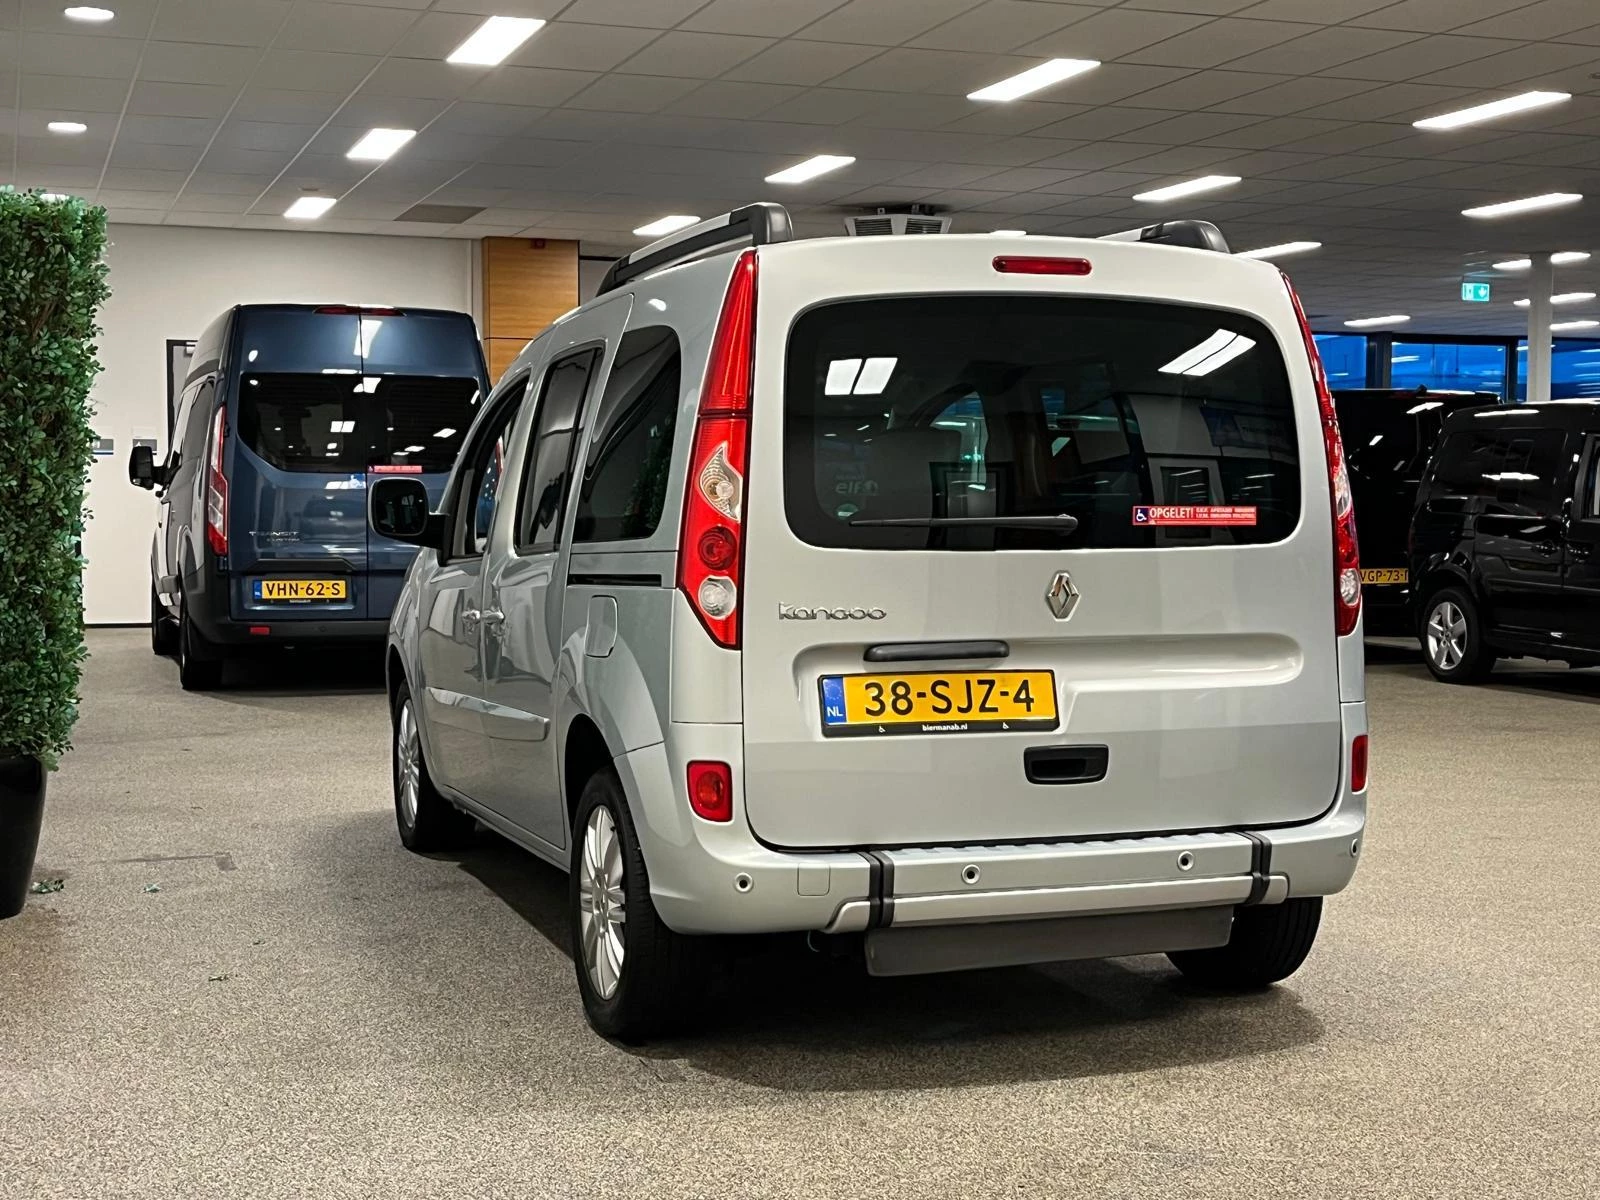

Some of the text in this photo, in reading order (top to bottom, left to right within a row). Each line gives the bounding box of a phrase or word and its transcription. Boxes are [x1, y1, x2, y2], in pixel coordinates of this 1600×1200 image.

[1149, 507, 1194, 519] OPGELET!
[265, 582, 341, 597] VHN-62-S
[778, 602, 888, 620] kangoo
[864, 679, 1035, 717] 38-SJZ-4
[827, 706, 843, 718] NL
[922, 722, 968, 732] biermanab.nl
